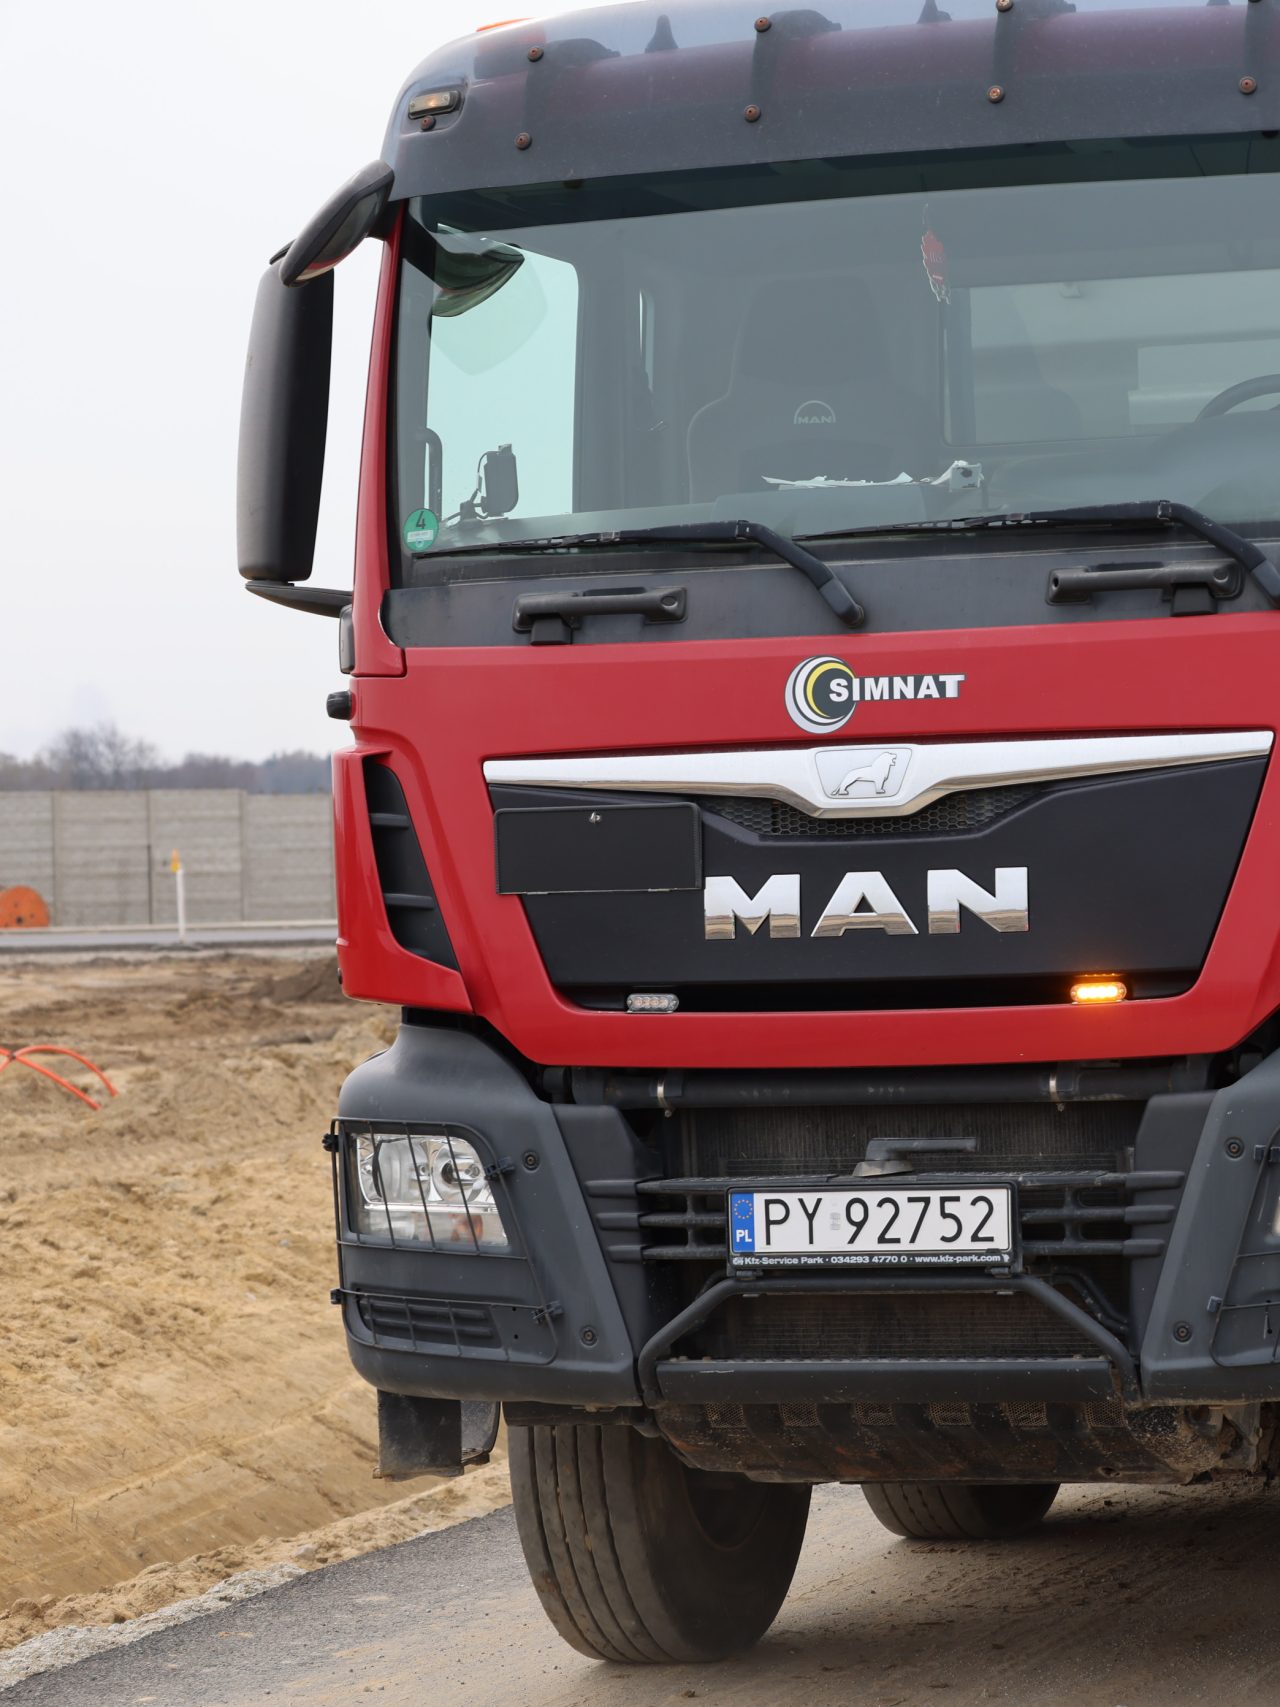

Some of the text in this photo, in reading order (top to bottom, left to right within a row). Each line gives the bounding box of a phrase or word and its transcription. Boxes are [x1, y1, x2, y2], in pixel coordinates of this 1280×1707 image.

[798, 415, 832, 425] MAN
[416, 511, 426, 530] 4
[829, 674, 966, 703] SIMNAT
[704, 866, 1029, 940] MAN
[764, 1195, 995, 1246] PY 92752
[736, 1229, 752, 1243] PL
[745, 1256, 799, 1265] Kfz-Service
[801, 1256, 824, 1265] Park
[831, 1255, 869, 1264] 034293
[872, 1255, 898, 1264] 4770
[915, 1254, 1001, 1264] www.kfz-park.com
